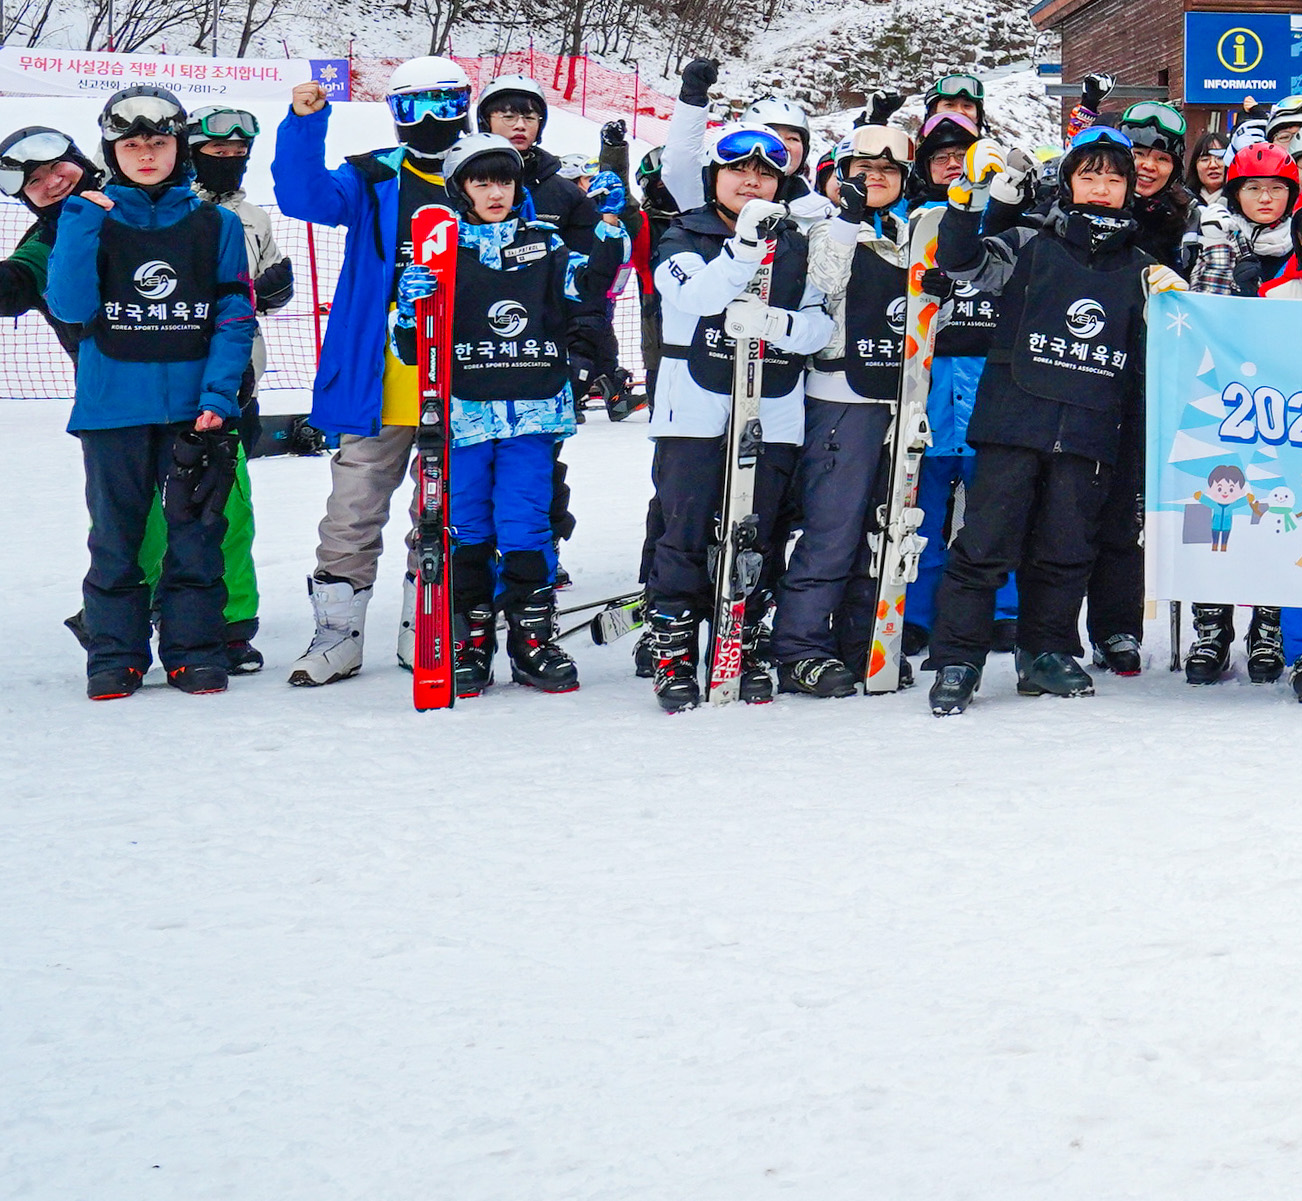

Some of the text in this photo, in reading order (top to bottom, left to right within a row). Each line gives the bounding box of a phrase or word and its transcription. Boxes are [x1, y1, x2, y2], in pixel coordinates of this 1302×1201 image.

[19, 56, 283, 82] 무허가 사설강습 적발 시 퇴장 조치합니다.
[77, 79, 121, 91] 신고전화
[1204, 79, 1276, 89] INFORMATION
[104, 301, 211, 321] 한국체육회
[160, 323, 201, 331] ASSOCIATION
[455, 339, 559, 362] 한국체육회
[709, 351, 727, 360] KOREA
[1028, 333, 1128, 370] 한국체육회
[428, 347, 437, 383] NORDICA
[464, 362, 484, 370] KOREA
[511, 361, 551, 369] ASSOCIATION
[1033, 356, 1115, 377] KOREA SPORTS ASSOCIATION
